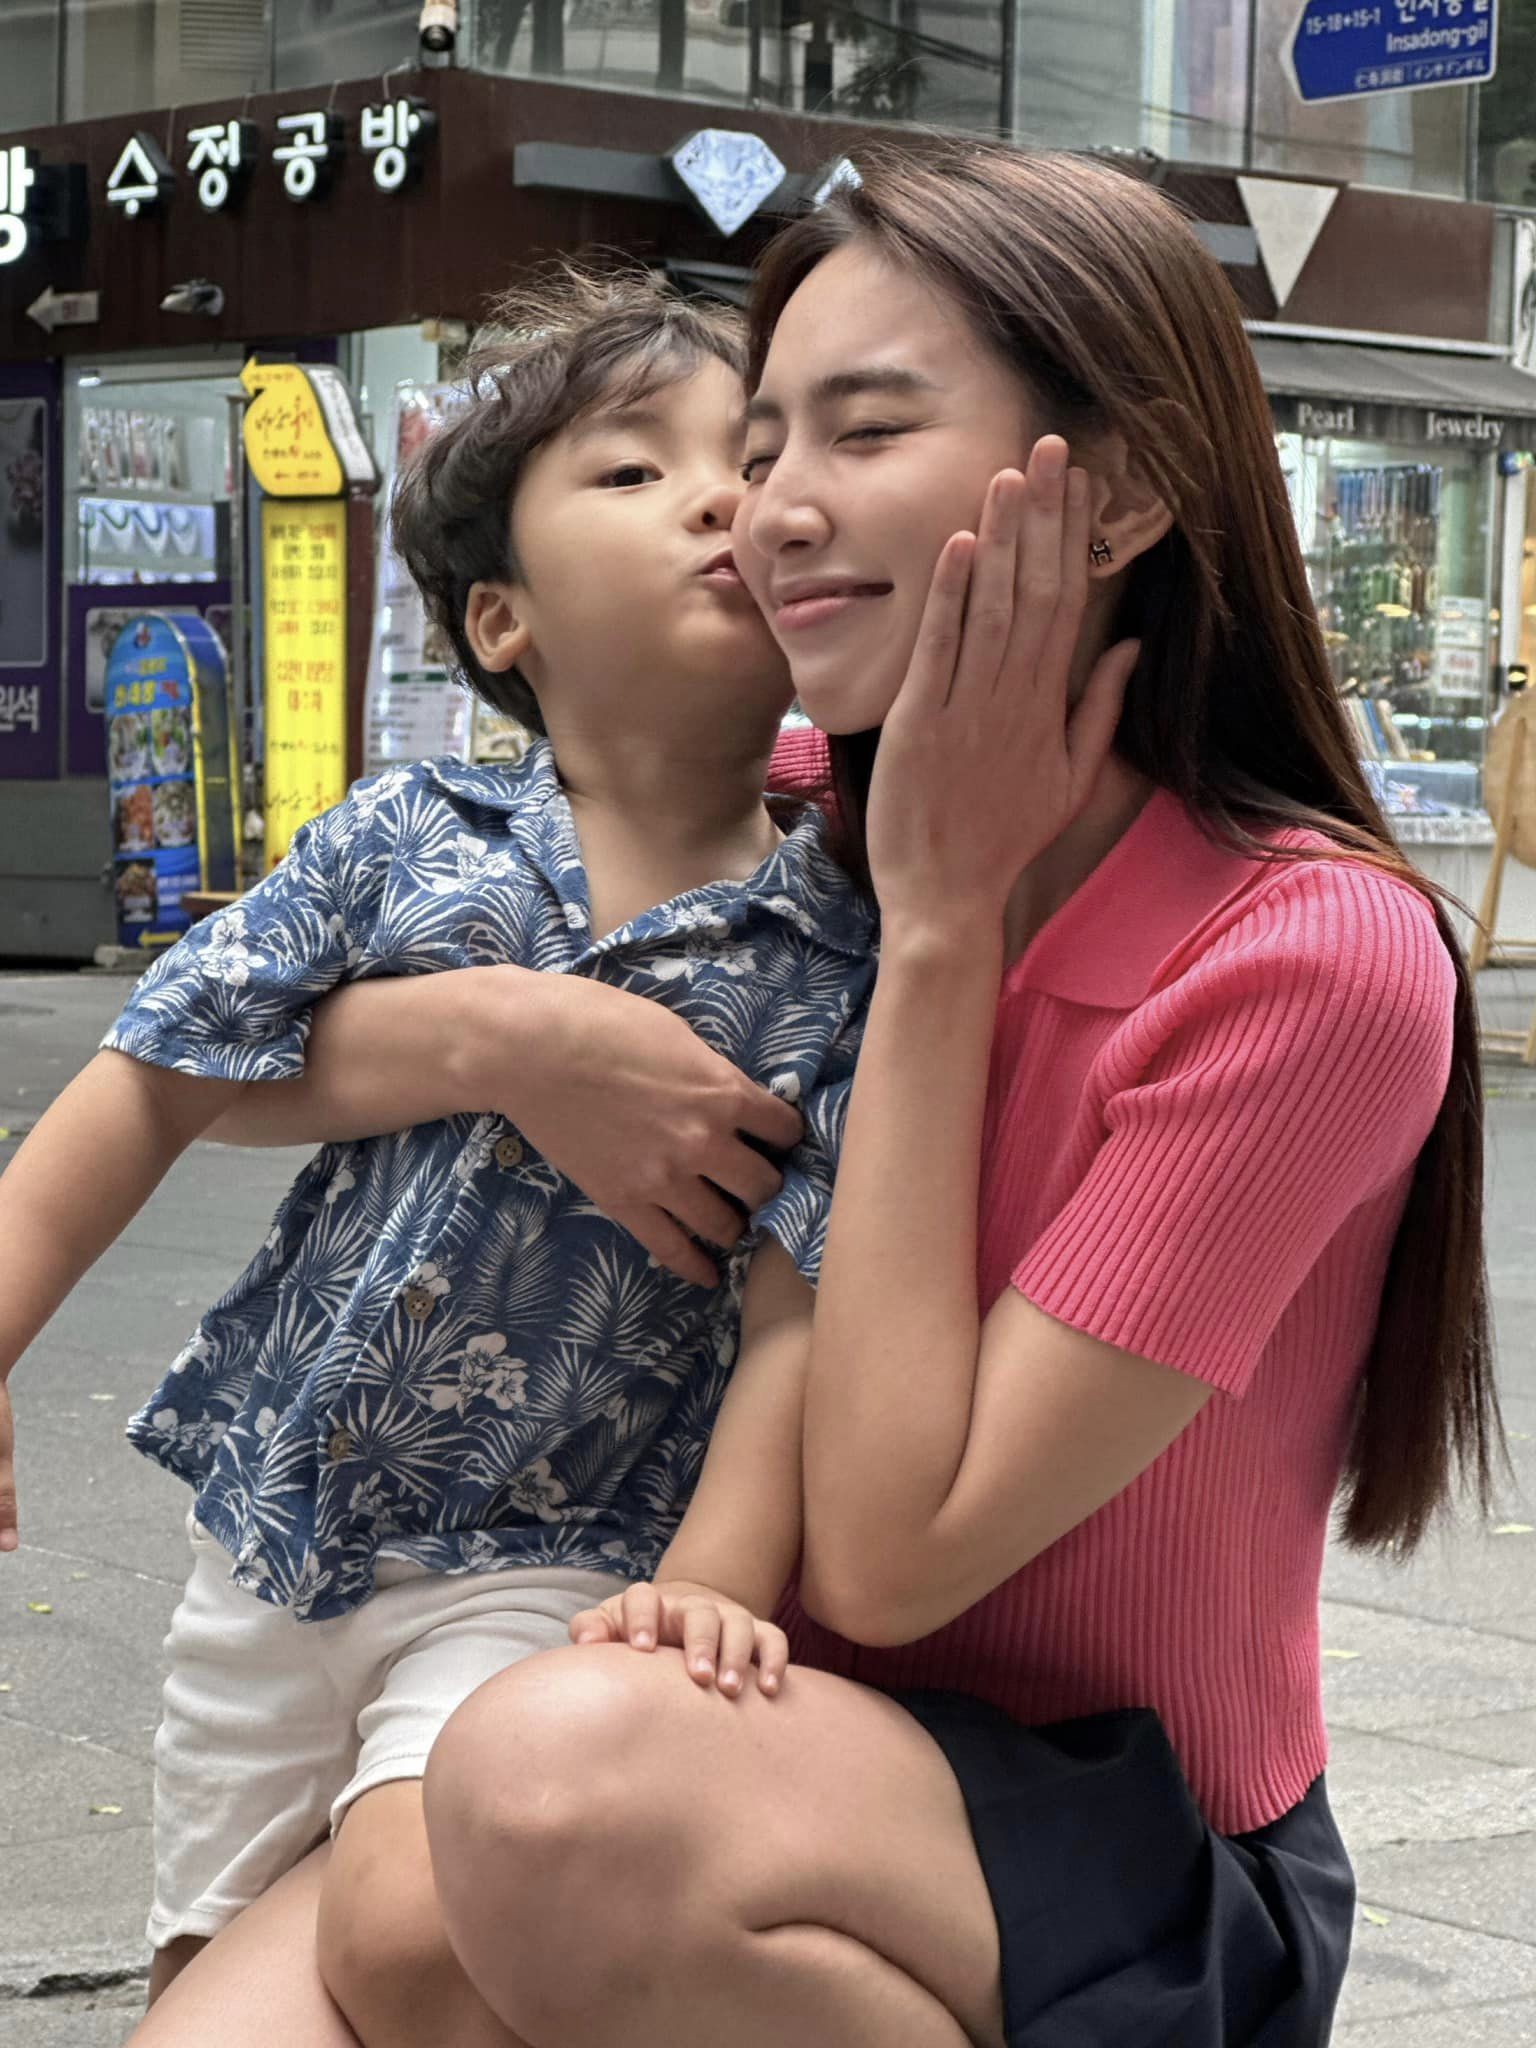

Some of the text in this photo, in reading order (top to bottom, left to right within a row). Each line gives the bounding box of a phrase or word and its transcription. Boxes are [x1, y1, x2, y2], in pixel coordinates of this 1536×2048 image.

[1386, 18, 1488, 53] Insadong-gil
[106, 99, 421, 215] 수정공방
[1297, 402, 1357, 432] Pearl
[1425, 411, 1505, 446] Jewelry
